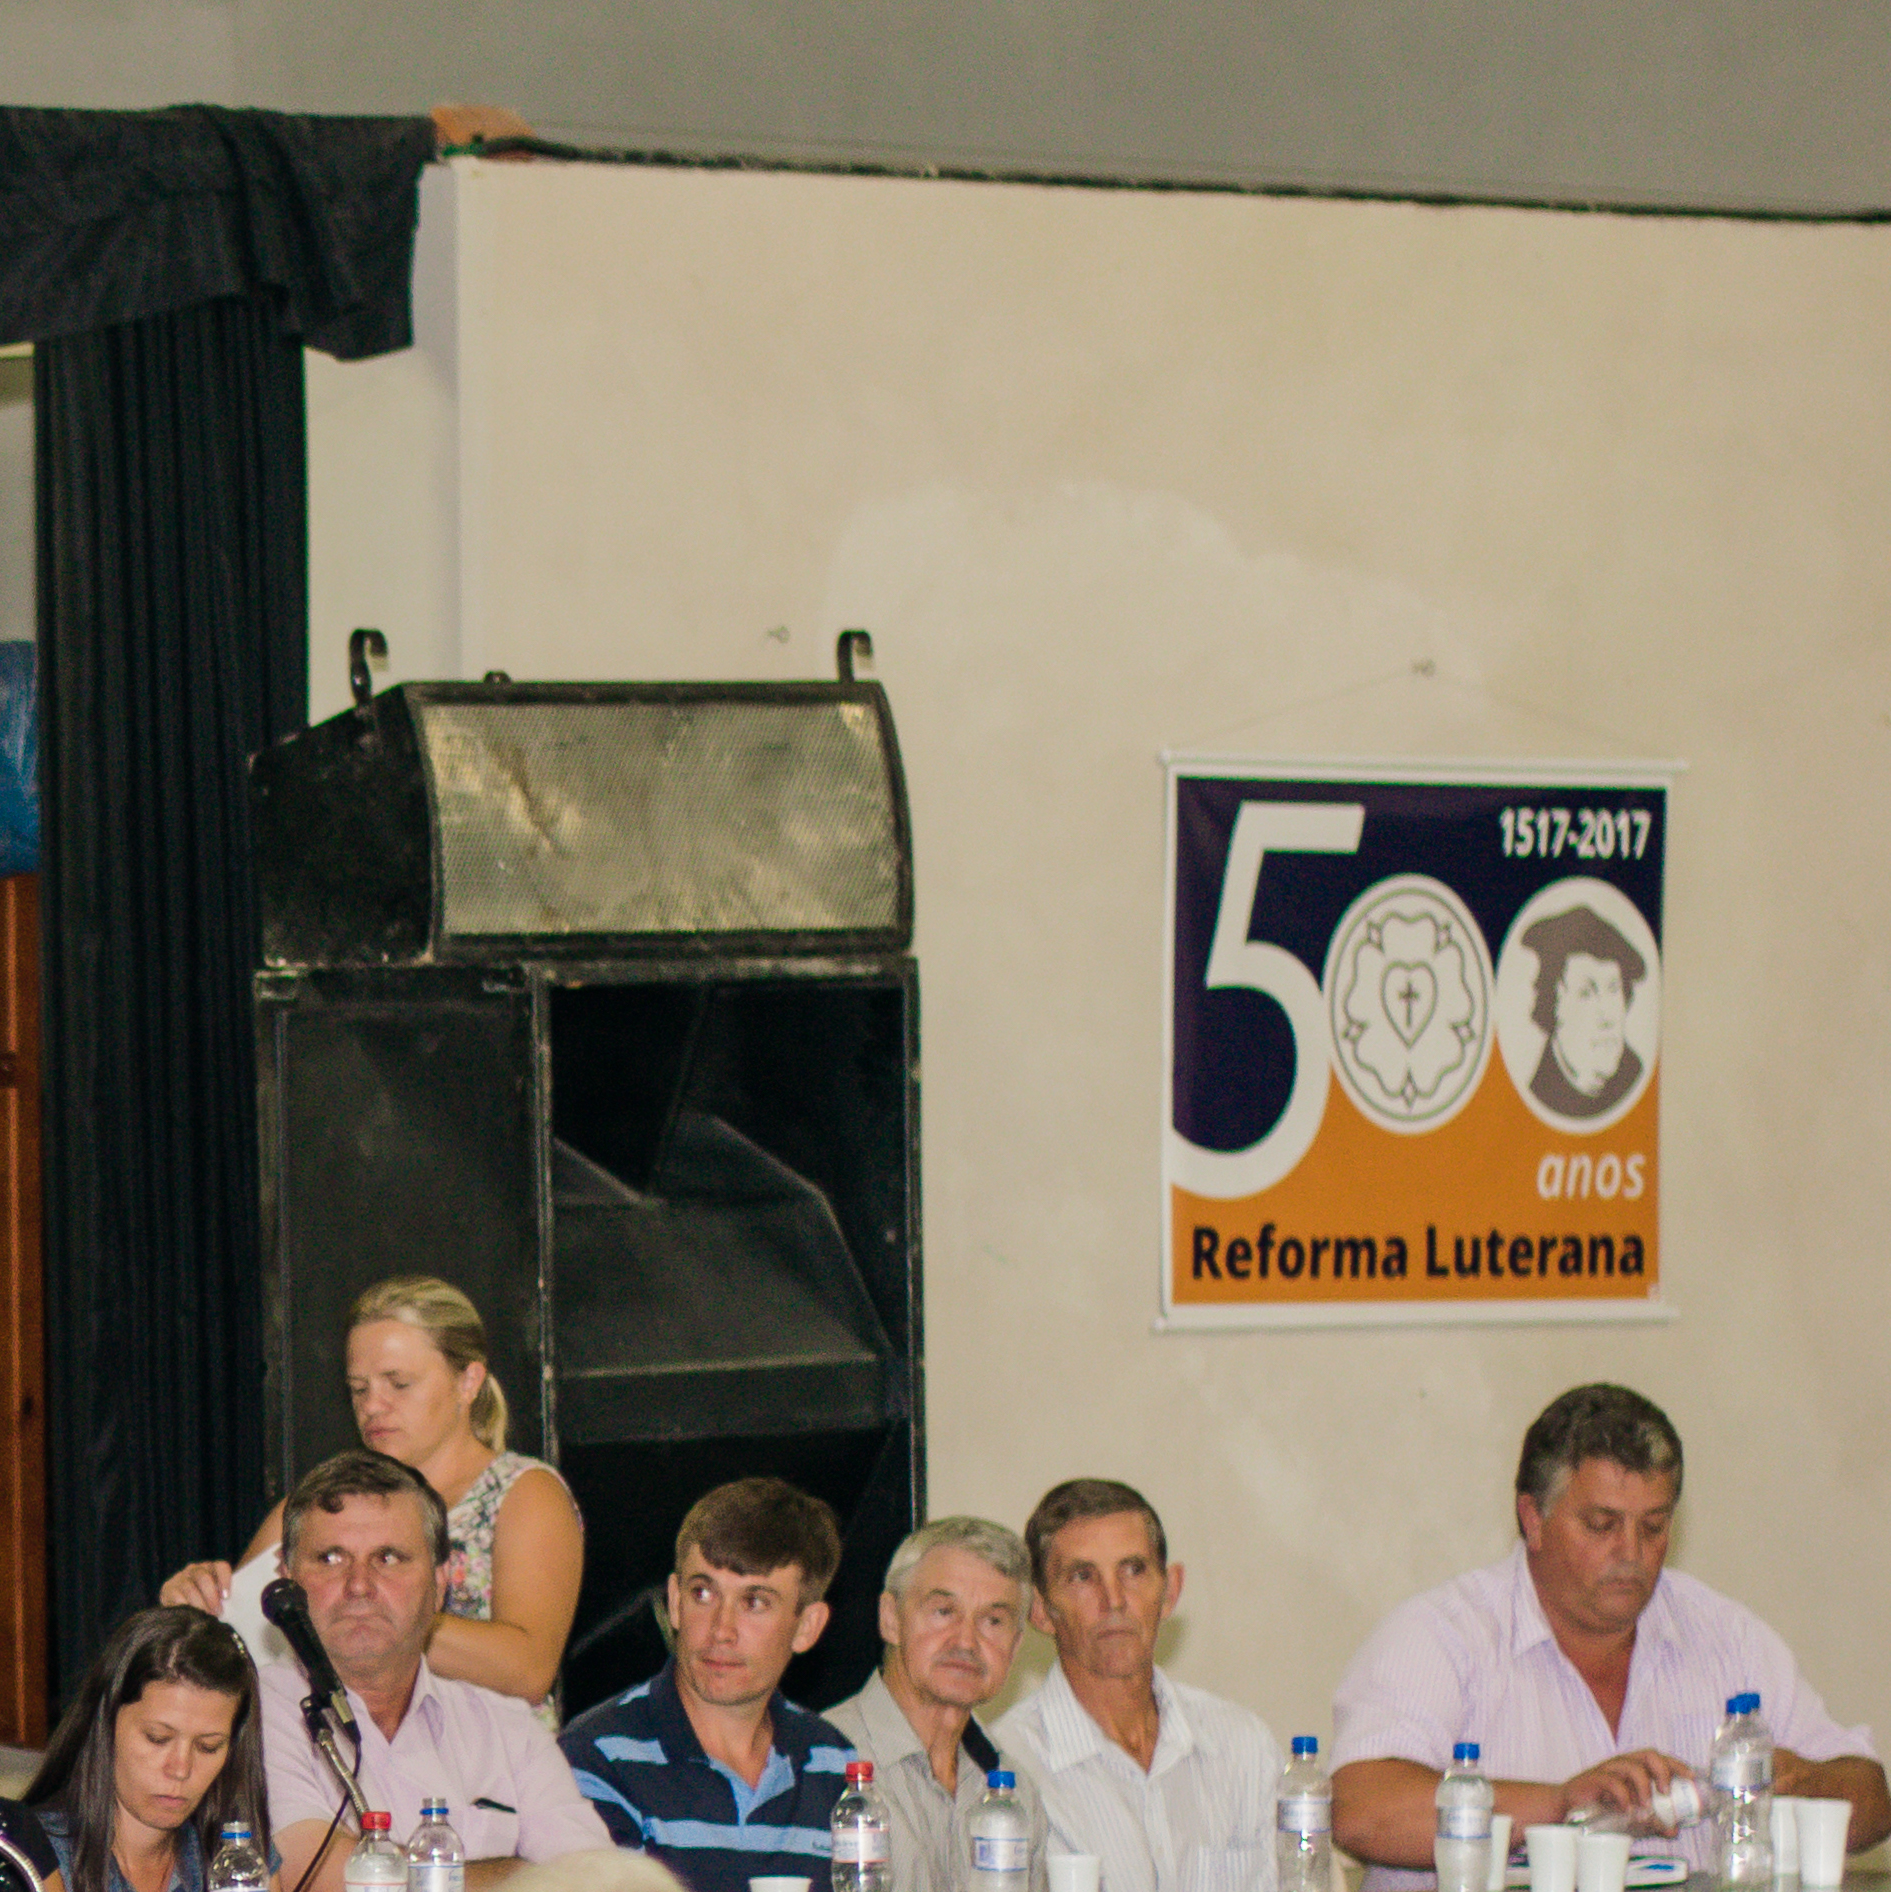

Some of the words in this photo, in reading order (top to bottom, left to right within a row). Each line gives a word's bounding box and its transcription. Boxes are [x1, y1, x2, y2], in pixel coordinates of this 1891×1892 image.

[1499, 806, 1653, 860] 1517-2017
[1536, 1153, 1646, 1199] anos
[1191, 1221, 1408, 1279] Reforma
[1425, 1224, 1645, 1278] Luterana
